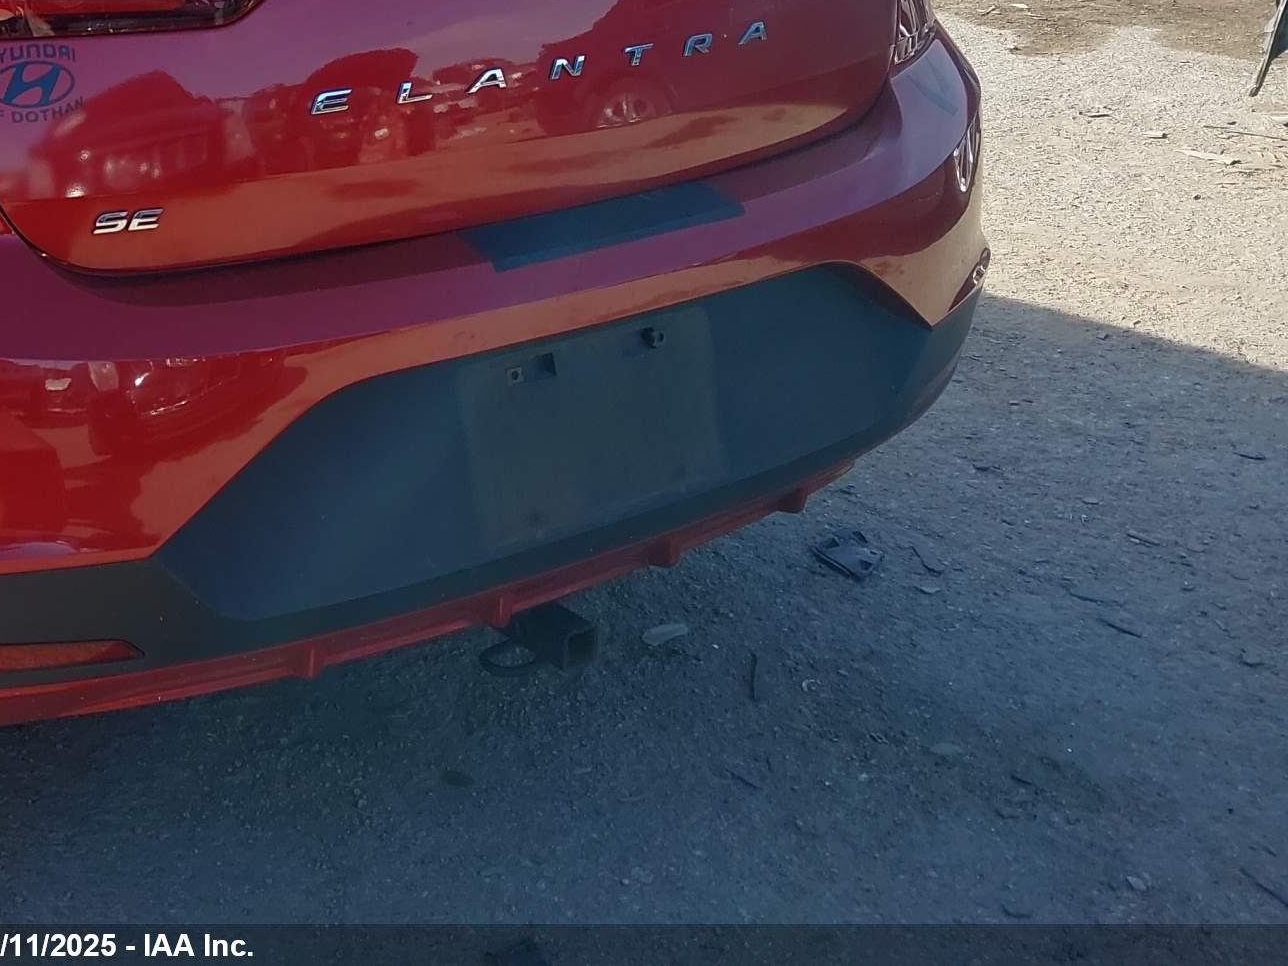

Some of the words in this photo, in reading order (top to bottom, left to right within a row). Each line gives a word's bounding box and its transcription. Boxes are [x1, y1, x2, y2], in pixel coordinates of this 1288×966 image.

[311, 21, 767, 114] ELANTRA
[11, 96, 83, 123] DOTHAN
[93, 208, 164, 234] SE
